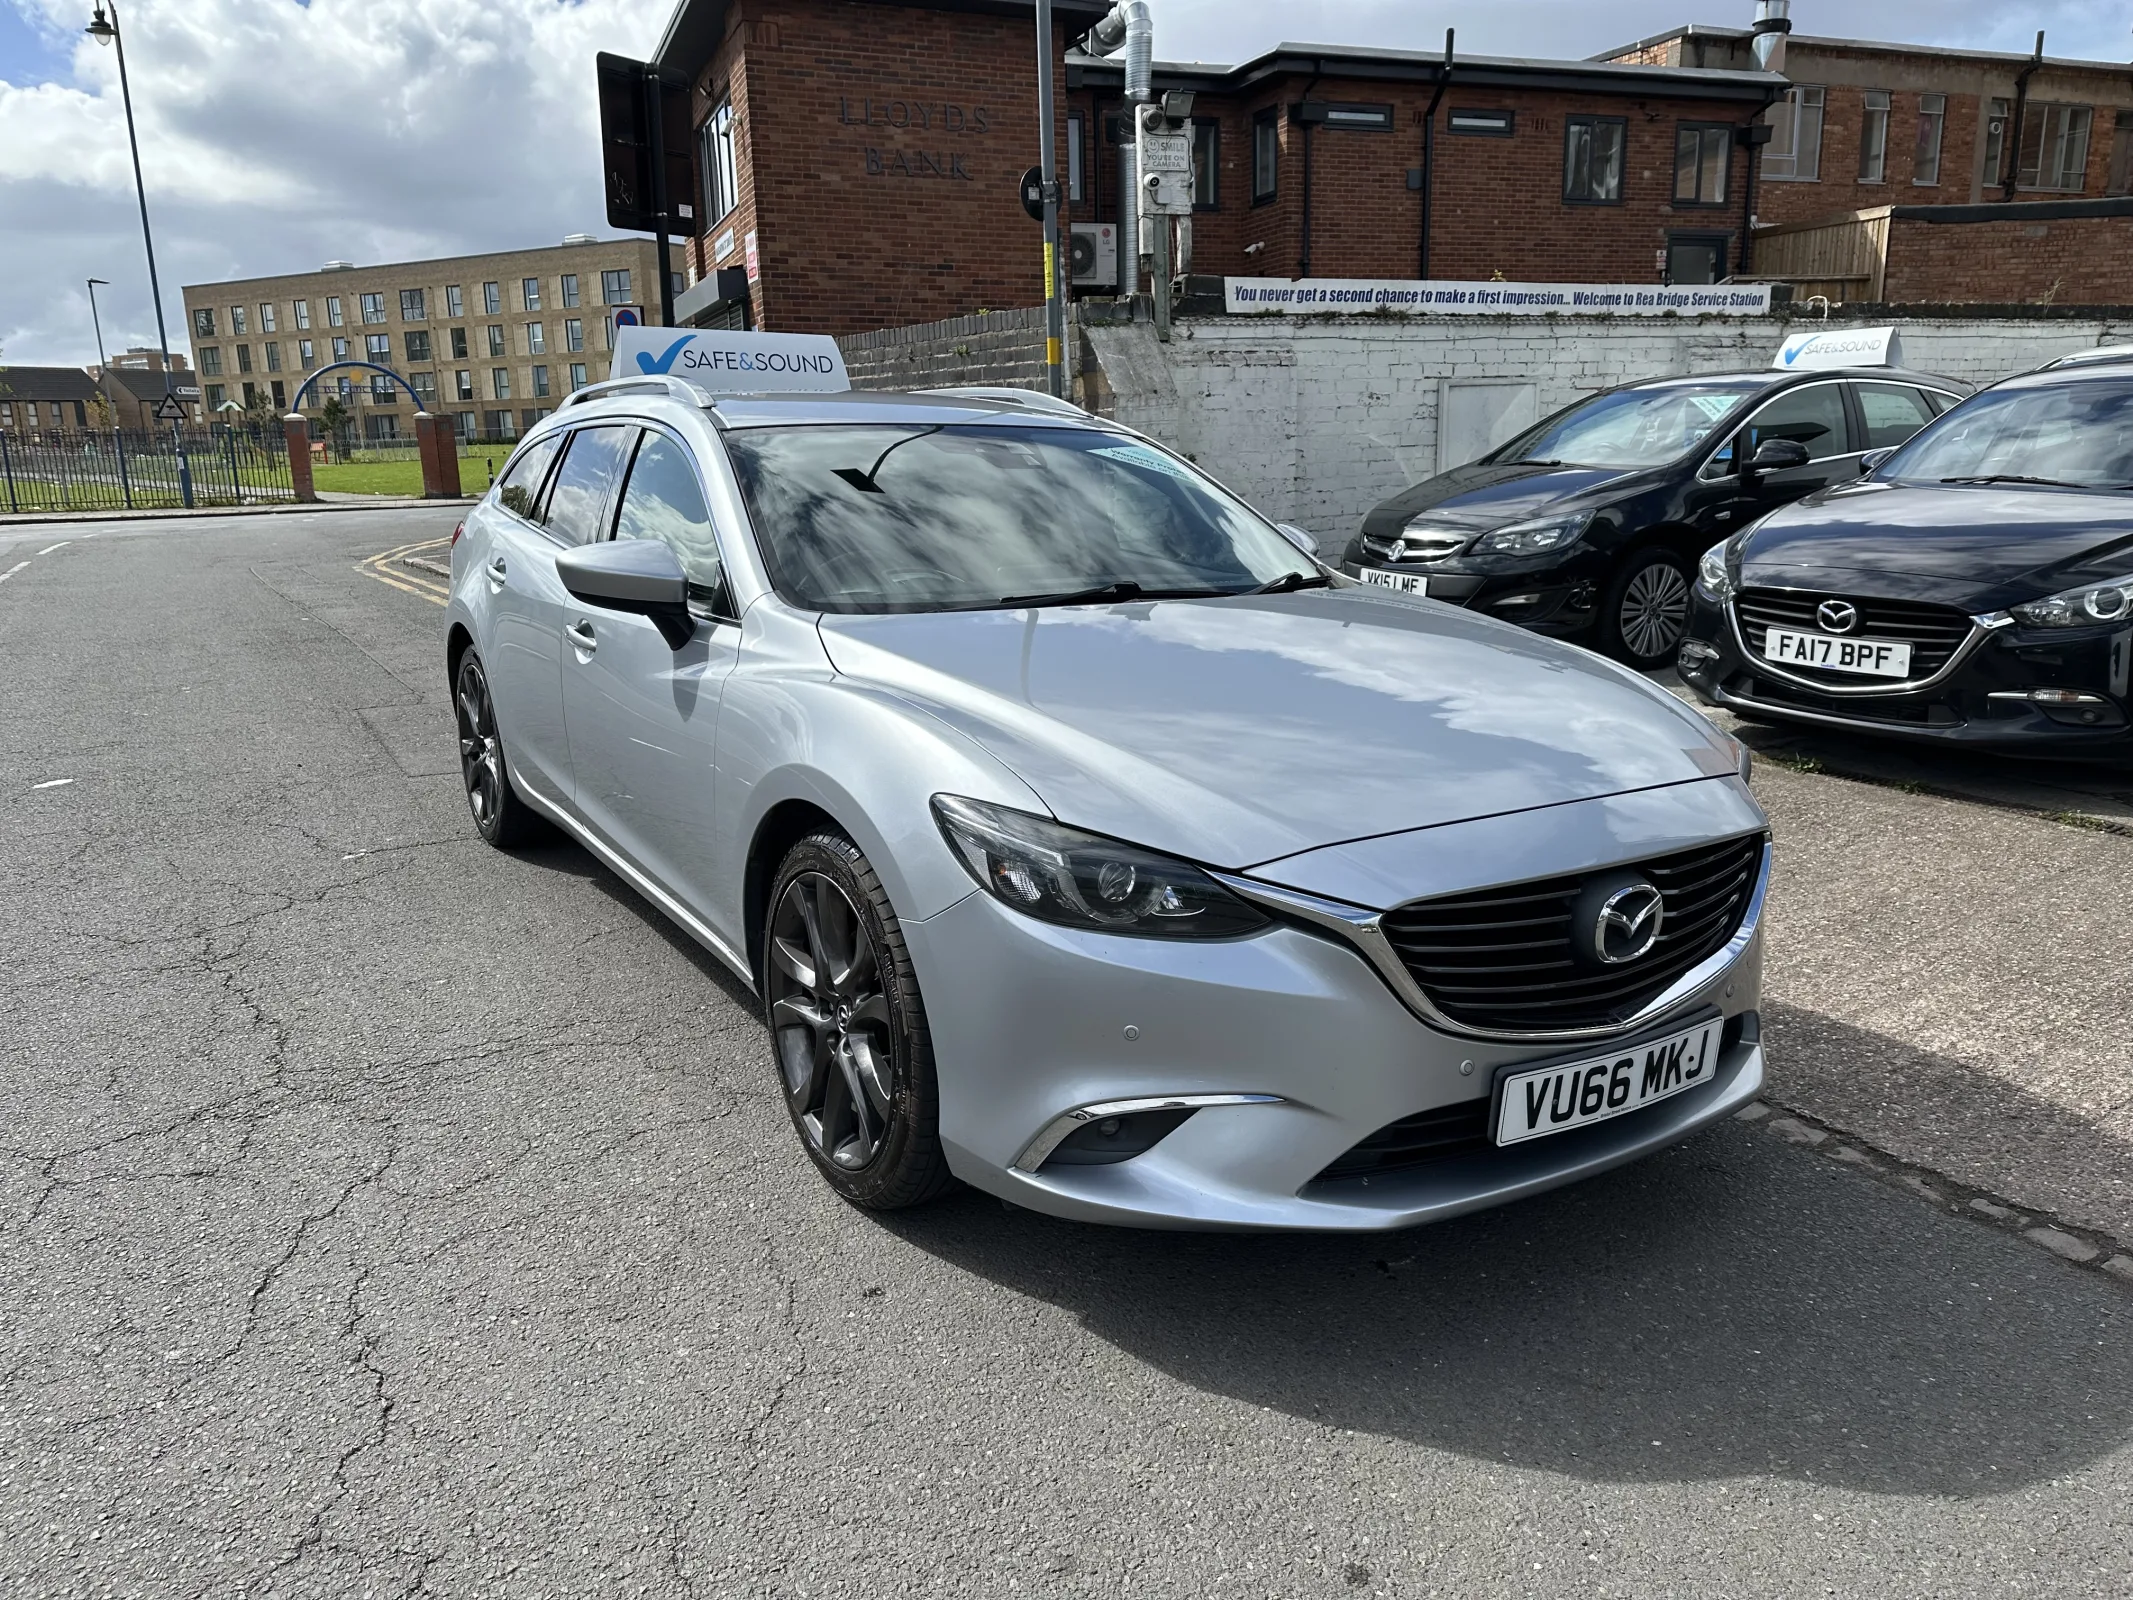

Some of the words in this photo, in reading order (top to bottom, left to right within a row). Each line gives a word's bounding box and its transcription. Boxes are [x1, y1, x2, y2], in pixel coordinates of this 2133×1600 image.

[840, 96, 990, 134] LLOYDS
[1160, 142, 1184, 152] SMILE
[864, 146, 975, 181] BANK
[1152, 160, 1181, 168] CAMERA
[1235, 286, 1257, 301] You
[1259, 288, 1296, 302] never
[1296, 287, 1317, 304] get
[1319, 290, 1327, 302] a
[1328, 287, 1374, 303] second
[1375, 288, 1419, 304] chance
[1420, 289, 1434, 303] to
[1434, 289, 1466, 304] make
[1468, 291, 1476, 304] a
[1477, 290, 1501, 305] first
[1502, 290, 1571, 306] impression...
[1572, 291, 1622, 306] Welcome
[1623, 292, 1634, 306] to
[1635, 292, 1655, 306] Rea
[1656, 291, 1691, 308] Bridge
[1691, 292, 1728, 307] Service
[1729, 292, 1765, 307] Station
[1804, 339, 1882, 355] SAFE&SOUND
[683, 349, 834, 374] SAFE&SOUND
[1779, 634, 1832, 663] FA17
[1839, 642, 1893, 670] BPF
[1525, 1057, 1634, 1130] VU66
[1639, 1029, 1710, 1099] MKJ
